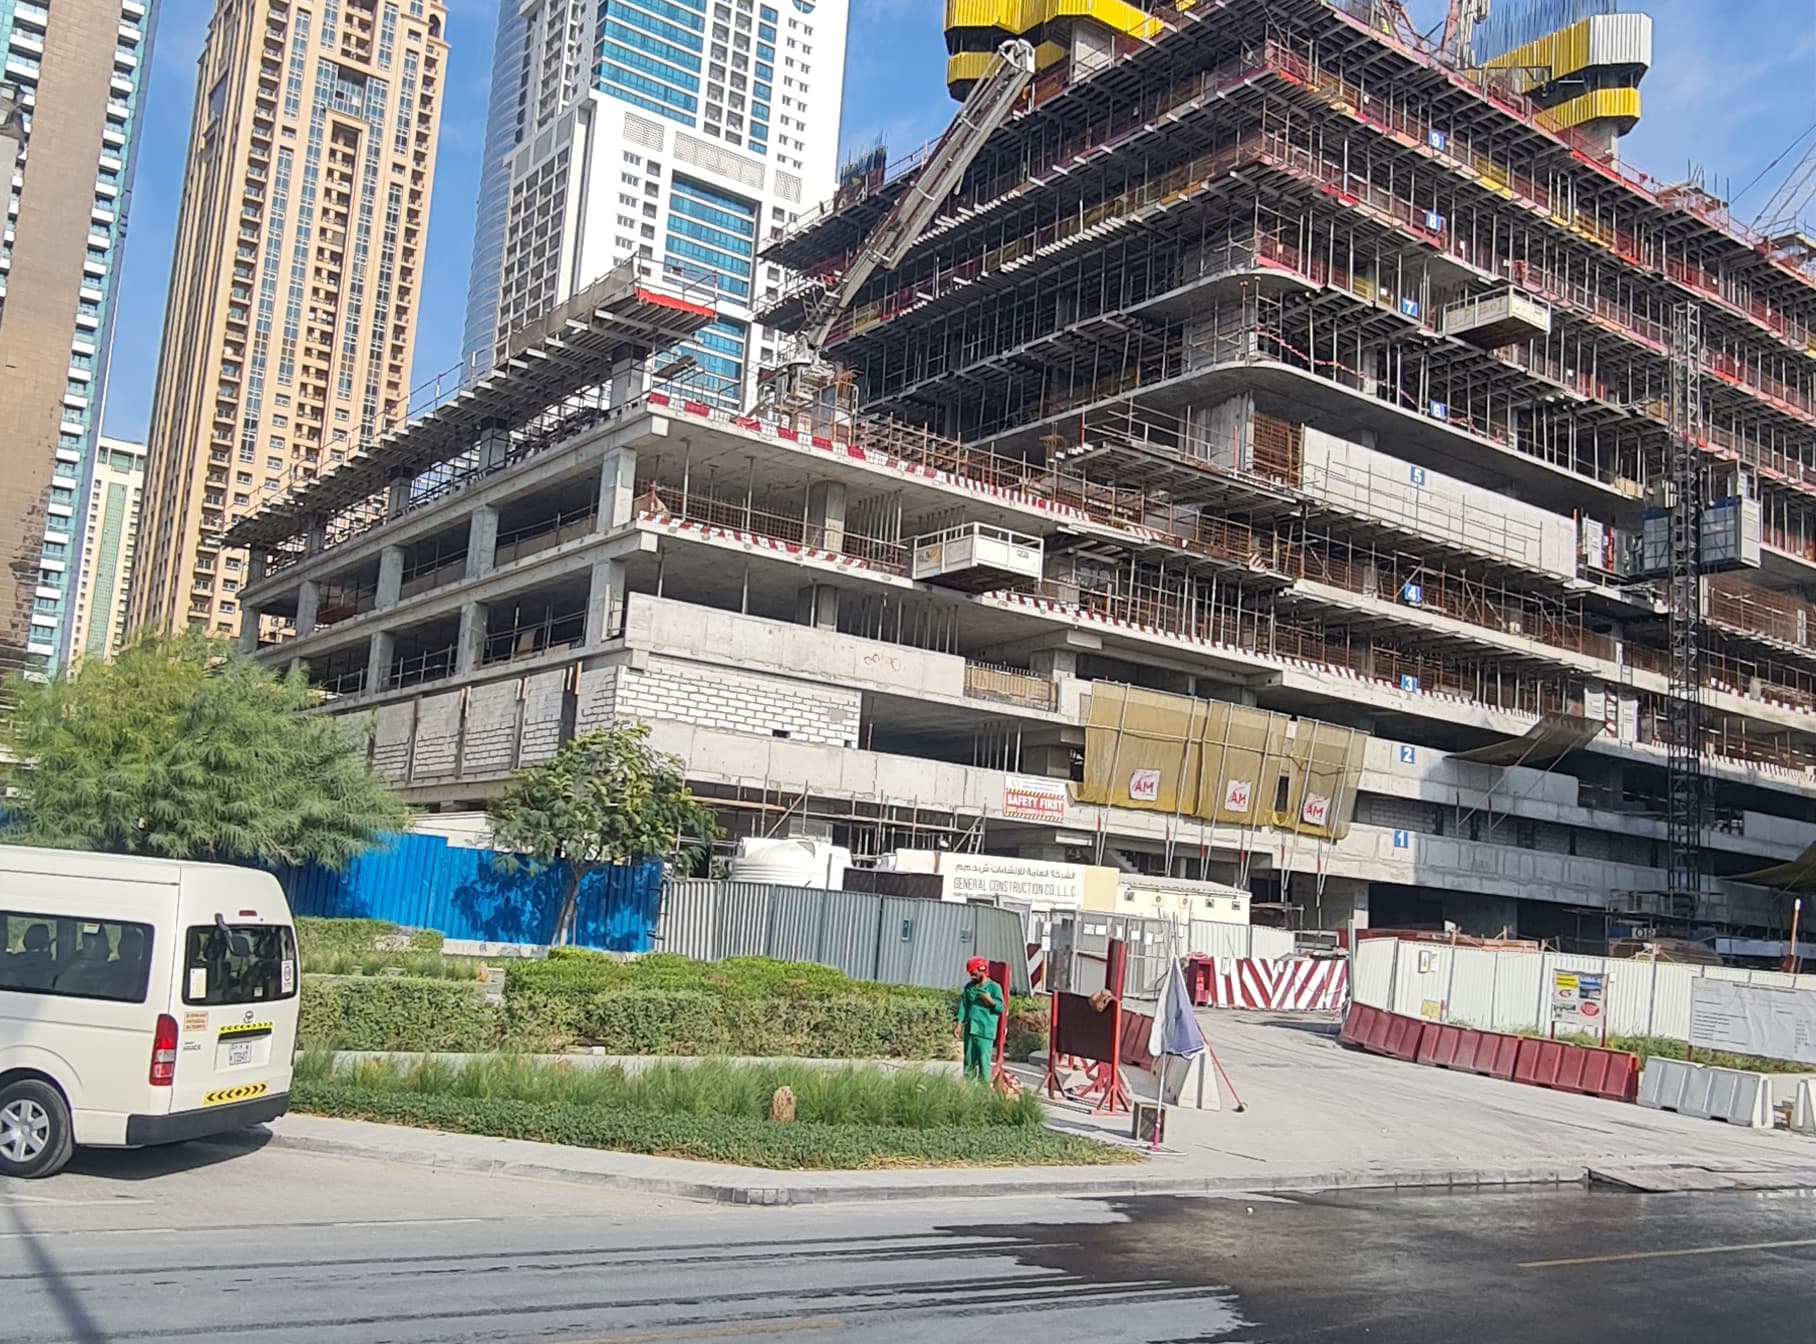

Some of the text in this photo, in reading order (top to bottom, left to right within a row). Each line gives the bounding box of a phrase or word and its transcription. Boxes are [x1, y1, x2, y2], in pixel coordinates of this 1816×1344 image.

[1405, 302, 1414, 314] 7
[1414, 468, 1422, 483] 5
[1407, 586, 1417, 601] 4
[1405, 677, 1413, 691] 3
[1402, 747, 1412, 762] 2
[1007, 794, 1037, 809] SAFETY
[1039, 798, 1063, 813] FIRST
[954, 877, 987, 891] GENERAL
[989, 879, 1043, 895] CONSTRUCTION
